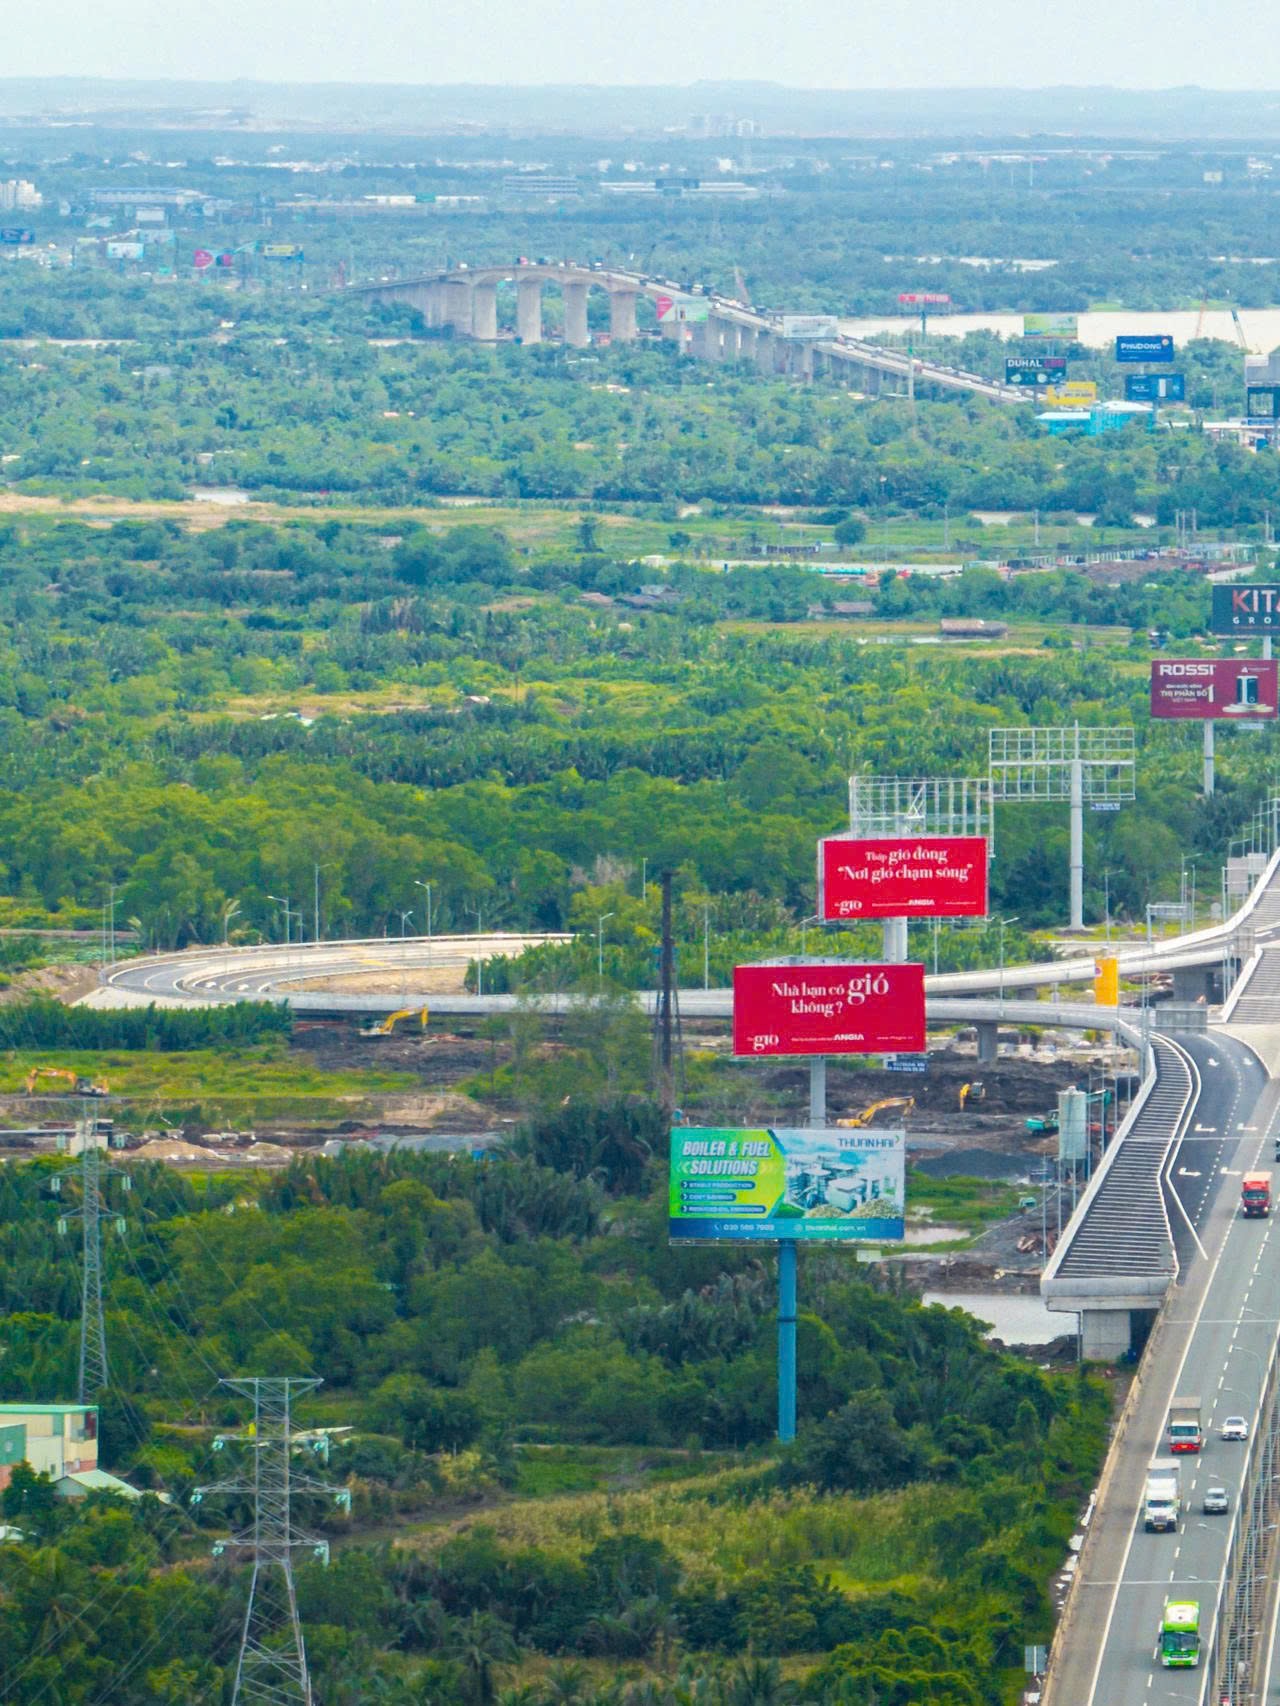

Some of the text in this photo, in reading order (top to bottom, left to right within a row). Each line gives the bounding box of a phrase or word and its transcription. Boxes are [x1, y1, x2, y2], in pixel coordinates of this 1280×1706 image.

[1007, 359, 1043, 368] DUHAL
[1160, 664, 1215, 676] ROSSI
[895, 863, 933, 881] chạm
[772, 973, 889, 1006] Nhà bạn có gió
[833, 1033, 865, 1041] ANGIA
[682, 1141, 771, 1158] BOILER & FUEL
[689, 1160, 758, 1176] SOLUTIONS
